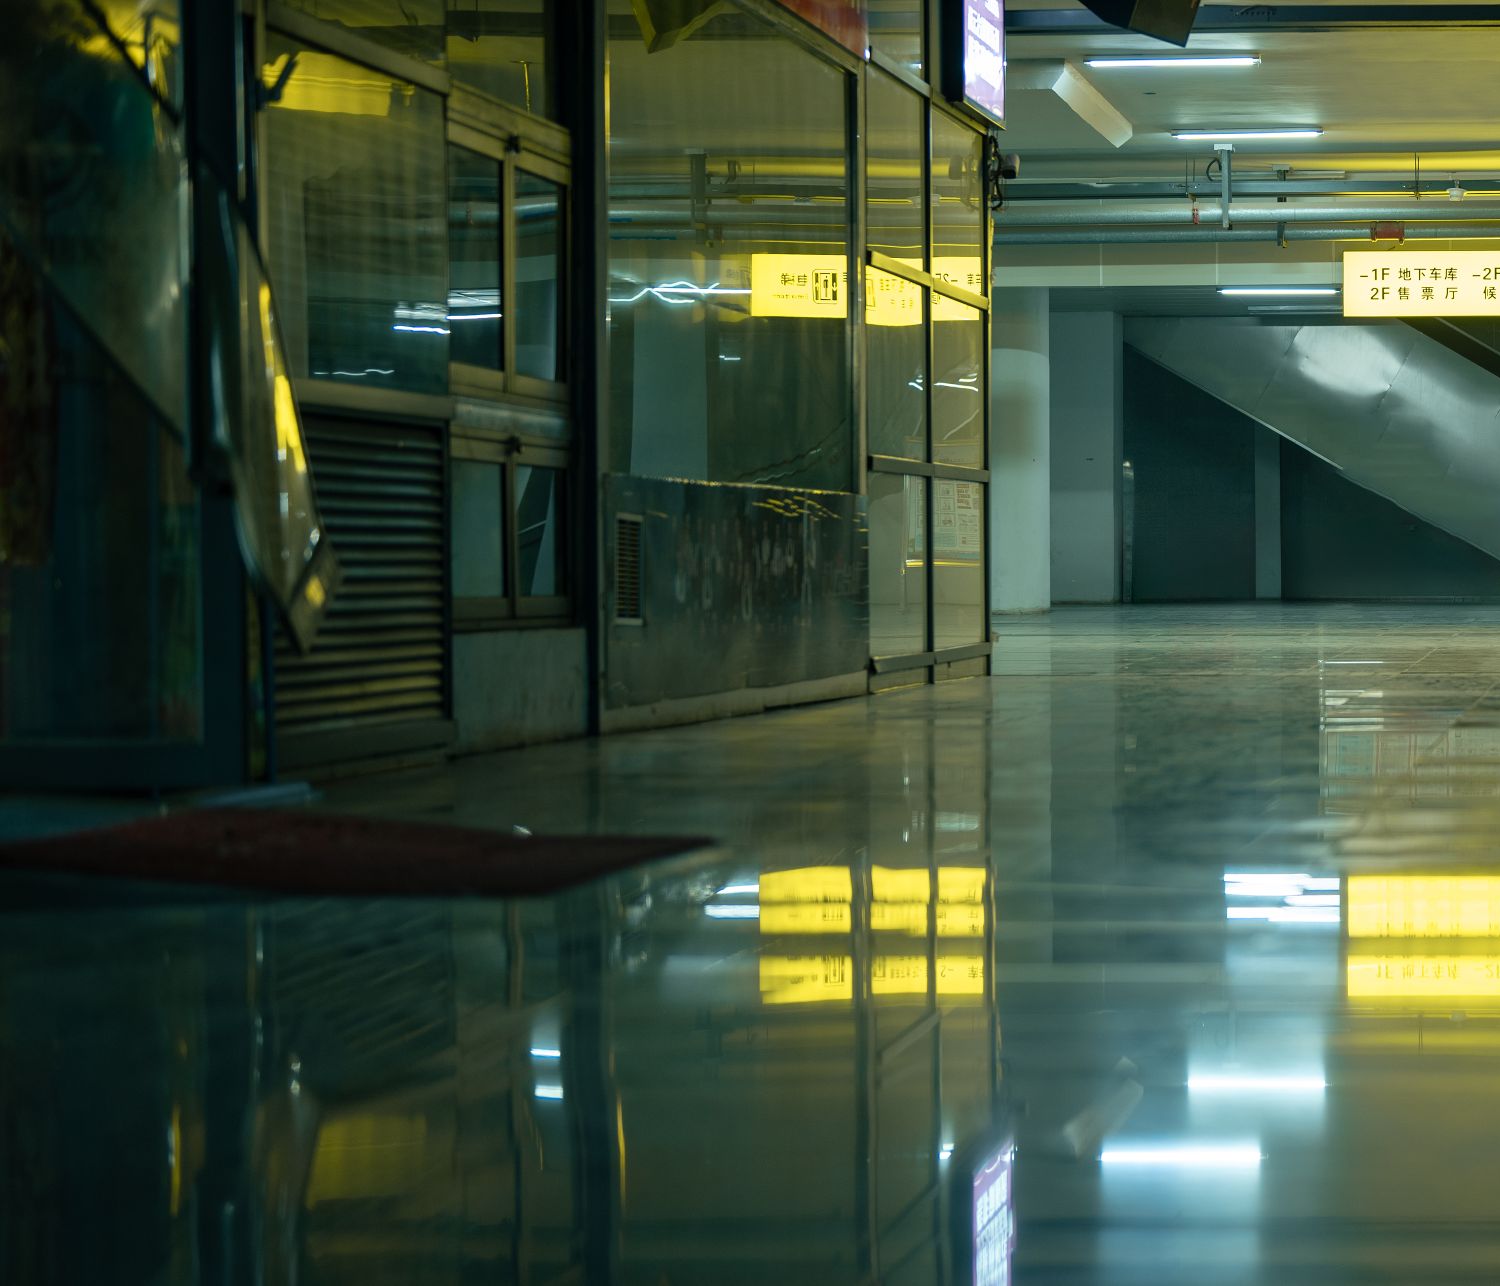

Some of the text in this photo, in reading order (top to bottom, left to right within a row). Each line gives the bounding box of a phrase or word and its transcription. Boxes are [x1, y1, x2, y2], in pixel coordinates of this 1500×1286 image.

[1398, 267, 1458, 281] 地下车库
[1370, 286, 1458, 300] 2F 售票厅
